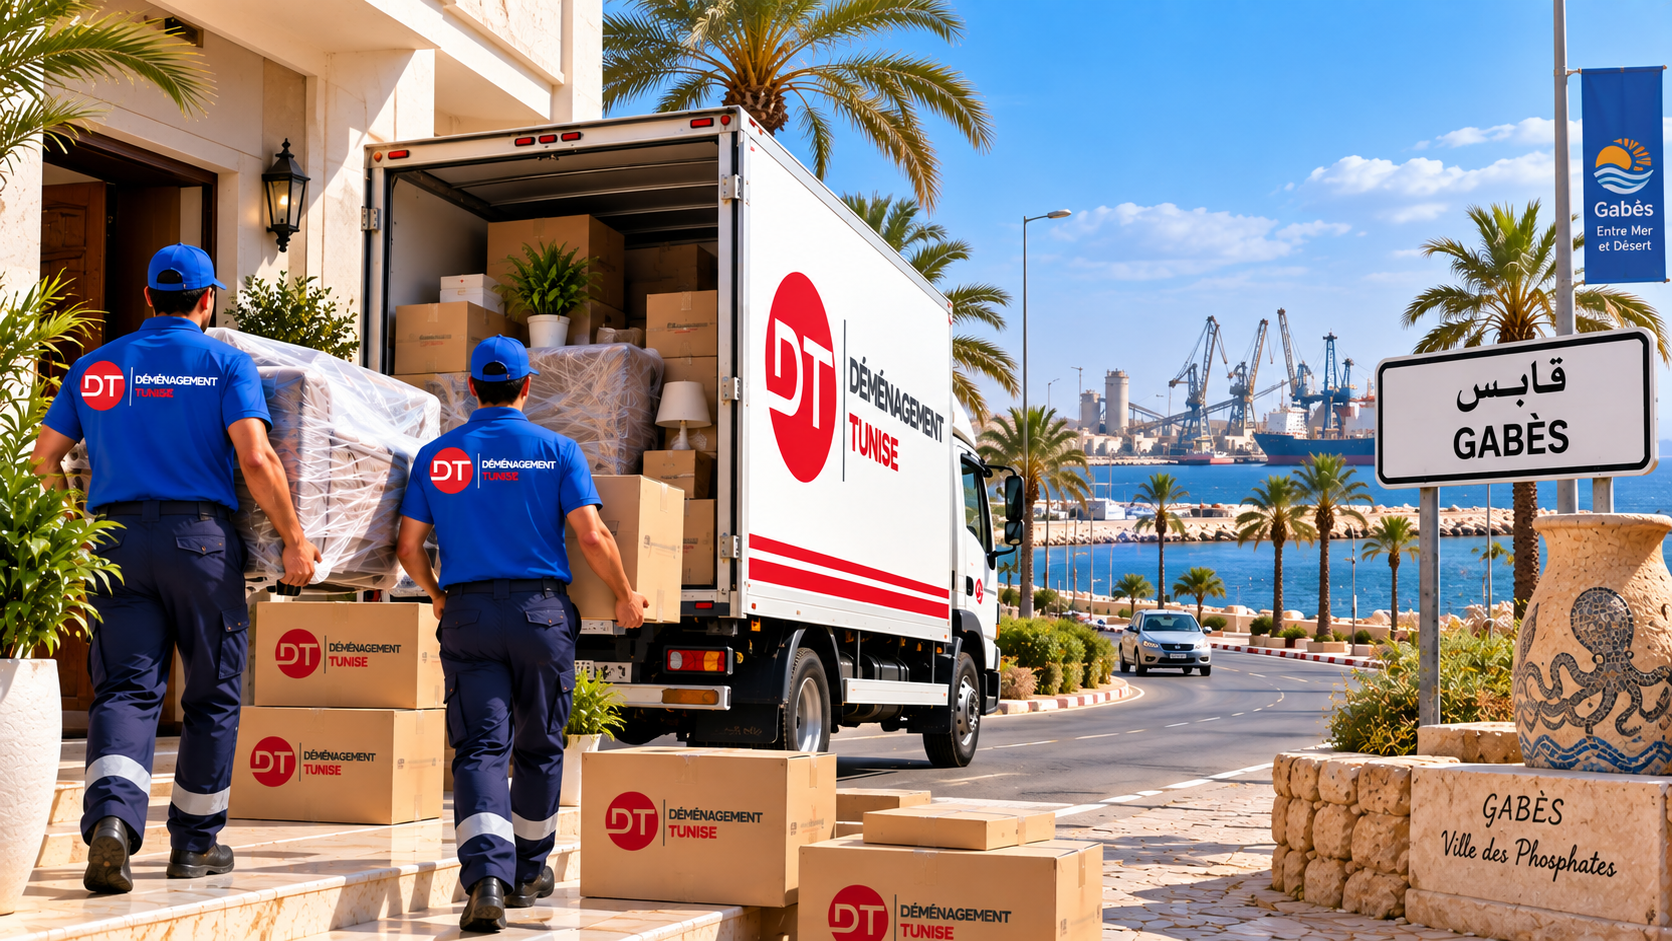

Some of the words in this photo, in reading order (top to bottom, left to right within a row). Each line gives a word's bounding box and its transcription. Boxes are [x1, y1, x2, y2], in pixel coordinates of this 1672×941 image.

[1594, 199, 1654, 218] Gabès
[1597, 225, 1627, 237] Entre
[1631, 225, 1653, 236] Mer
[1598, 241, 1610, 252] et
[1614, 239, 1652, 251] Désert
[135, 373, 218, 387] DÉMÉNAGEMENT
[767, 317, 834, 430] DT
[1456, 356, 1567, 412] قابس
[81, 375, 124, 397] DT
[849, 356, 944, 443] DÉMÉNAGEMENT
[849, 411, 898, 472] TUNISE
[1453, 412, 1569, 460] GABÈS
[430, 460, 471, 481] DT
[482, 458, 557, 470] DÉMÉNAGEMENT
[276, 643, 318, 666] DT
[329, 641, 401, 654] DÉMÉNAGEMENT
[328, 656, 368, 668] TUNISE
[252, 750, 293, 774] DT
[303, 749, 376, 762] DÉMÉNAGEMENT
[303, 764, 342, 776] TUNISE
[668, 806, 763, 823] DÉMÉNAGEMENT
[1482, 790, 1565, 828] GABÈS
[606, 808, 655, 836] DT
[668, 825, 717, 839] TUNISE
[1441, 829, 1477, 859] Ville
[1482, 836, 1509, 864] des
[1515, 837, 1618, 882] Phosphates
[829, 903, 885, 936] DT
[900, 902, 1011, 924] DÉMÉNAGEMENT
[900, 923, 954, 941] TUNISE
